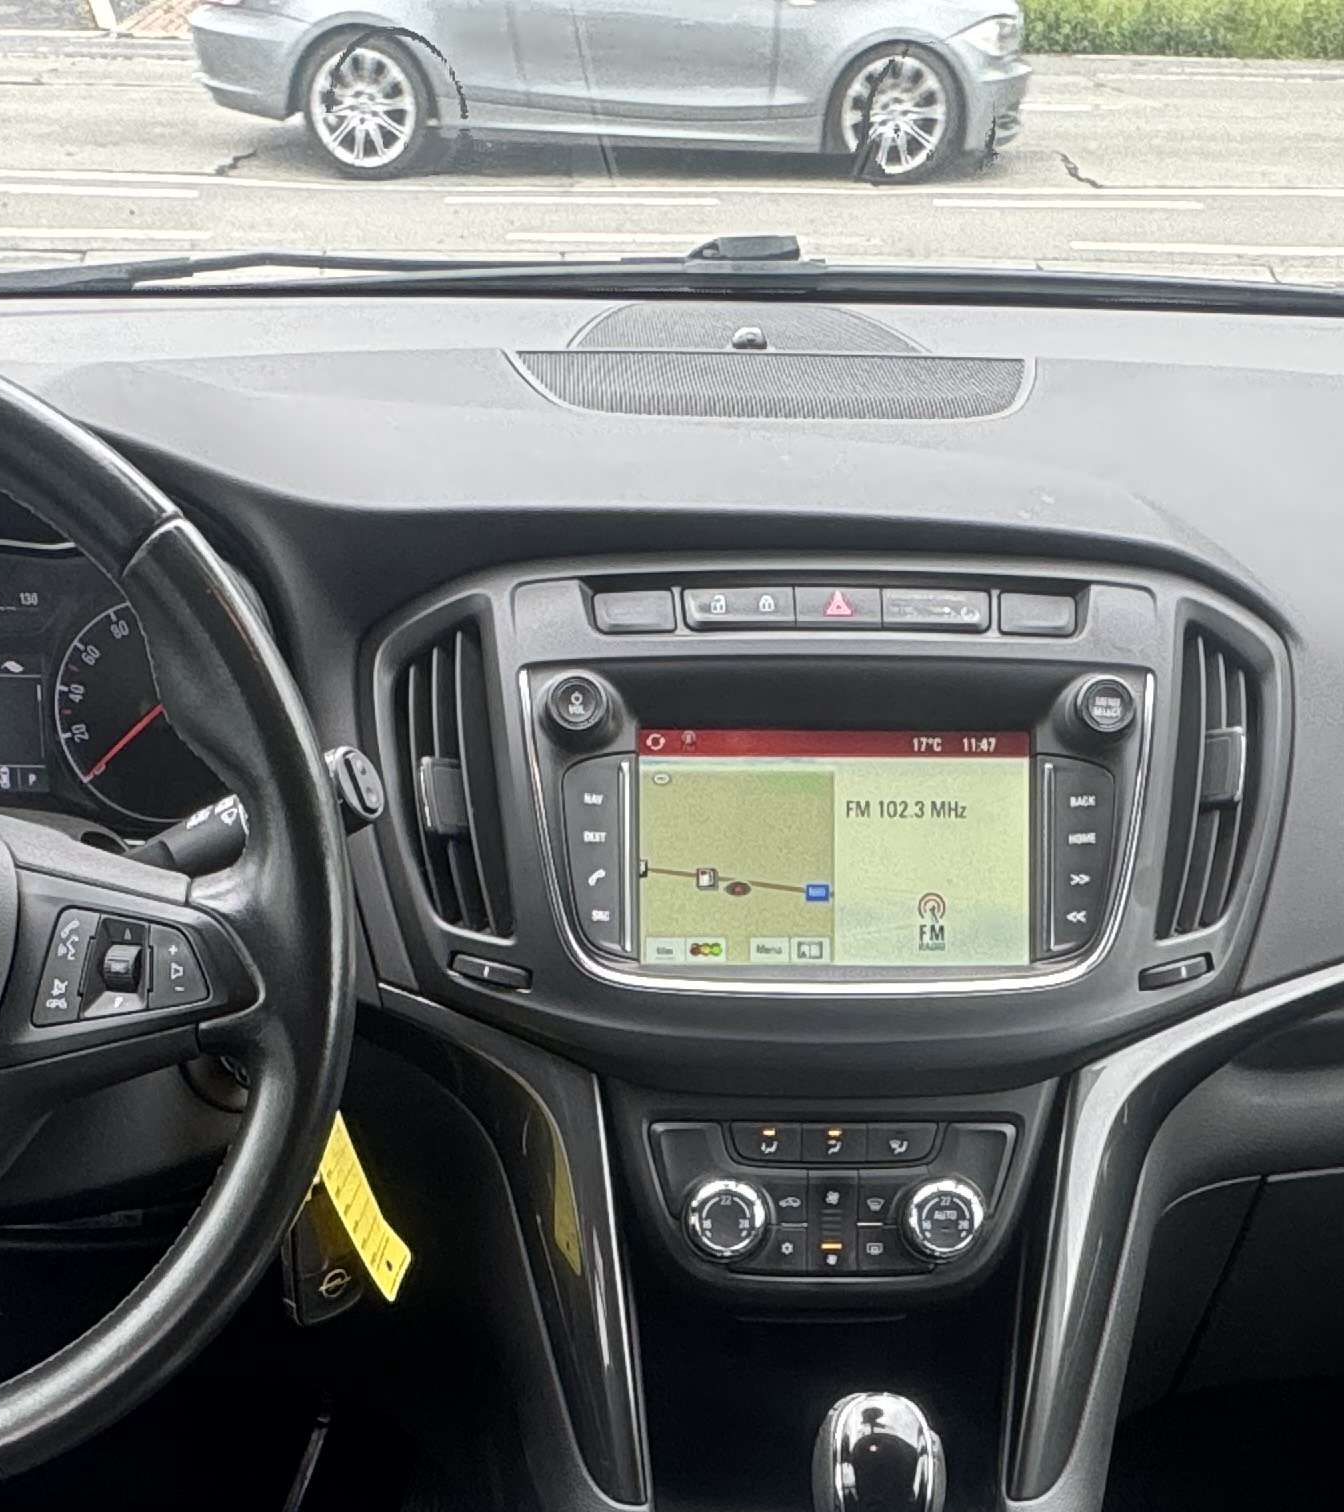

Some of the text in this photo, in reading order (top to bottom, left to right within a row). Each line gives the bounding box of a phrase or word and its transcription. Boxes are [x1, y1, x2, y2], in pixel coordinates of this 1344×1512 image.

[110, 619, 130, 640] 80
[81, 644, 101, 666] 60
[68, 683, 85, 703] 40
[71, 723, 89, 743] 20
[913, 736, 943, 751] 17°C
[962, 736, 997, 752] 11:47
[28, 773, 38, 786] P
[584, 793, 603, 805] NAV
[1070, 795, 1096, 808] BACK
[846, 800, 967, 818] FM 102.3 MHz
[1068, 832, 1096, 845] HOME
[919, 924, 946, 941] FM
